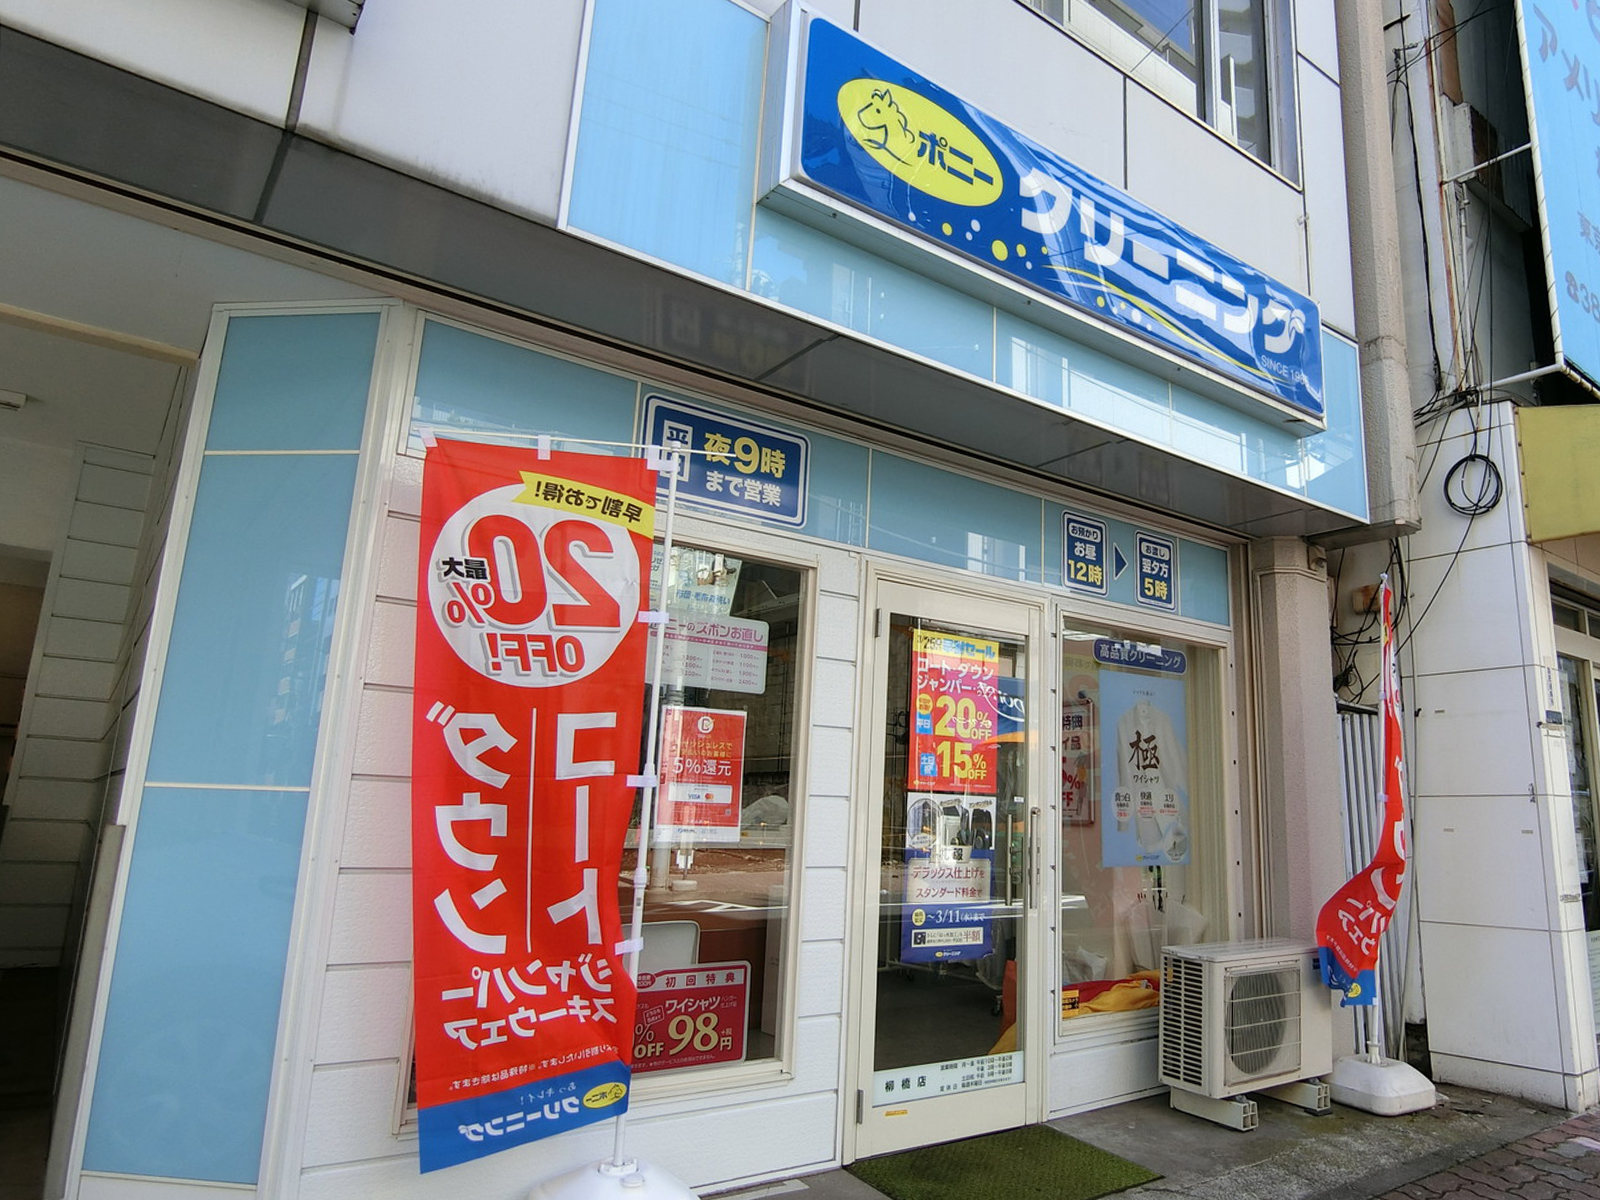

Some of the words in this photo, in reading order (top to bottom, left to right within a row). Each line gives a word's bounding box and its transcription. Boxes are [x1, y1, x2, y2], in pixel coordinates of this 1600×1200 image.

[917, 131, 994, 187] ポニー
[1019, 168, 1307, 353] クリーニング
[1261, 355, 1288, 377] SINCE
[703, 432, 786, 478] 夜9時
[706, 470, 781, 507] まで営業
[1071, 525, 1098, 540] お預かり
[1074, 541, 1096, 560] お昼
[1145, 545, 1165, 558] お渡し
[1068, 560, 1103, 585] 12時
[1142, 558, 1169, 578] 翌夕方
[1144, 577, 1168, 600] 5時
[970, 730, 992, 740] OFF
[1128, 730, 1160, 771] 極
[672, 757, 732, 776] 5%還元
[967, 769, 987, 780] OFF
[1133, 774, 1160, 784] ワイシャツ
[913, 866, 985, 879] デラックス仕上げを
[916, 887, 983, 898] スタンダード料金で
[665, 971, 736, 988] 初回特典
[666, 996, 721, 1014] ワイシャツ
[634, 1042, 664, 1058] OFF
